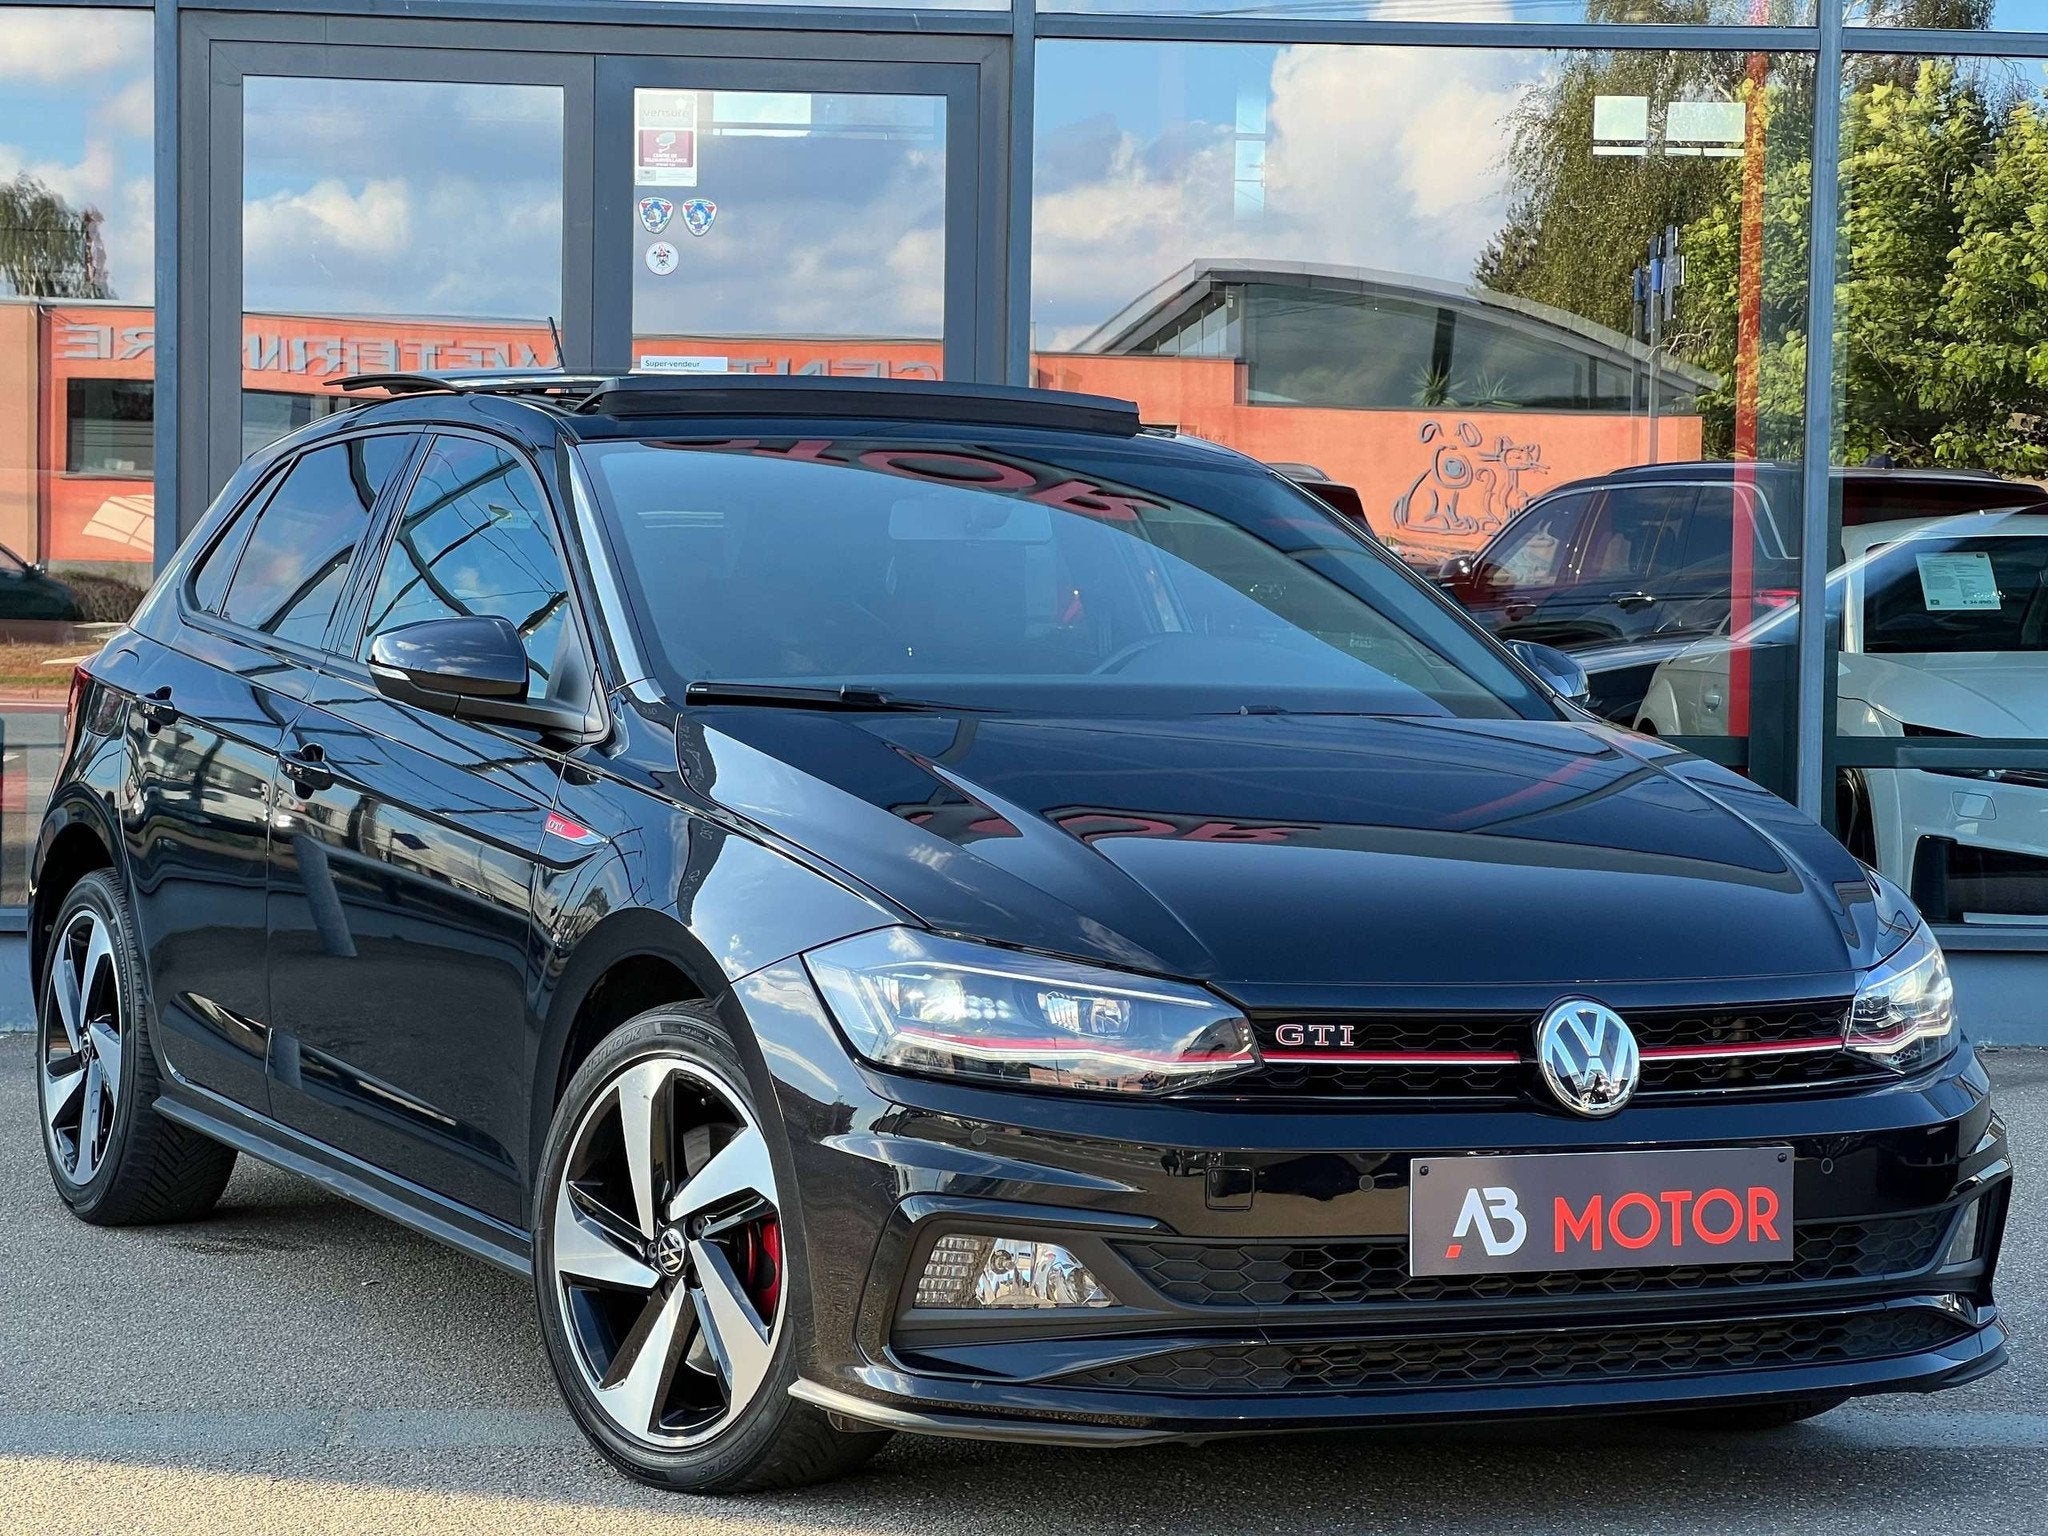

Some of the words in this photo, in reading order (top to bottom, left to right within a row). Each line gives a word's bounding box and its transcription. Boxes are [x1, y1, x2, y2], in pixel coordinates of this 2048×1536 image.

[645, 360, 701, 368] Super-vendeur
[1275, 1024, 1355, 1046] GTI
[1446, 1186, 1528, 1258] AB
[1554, 1187, 1781, 1253] MOTOR
